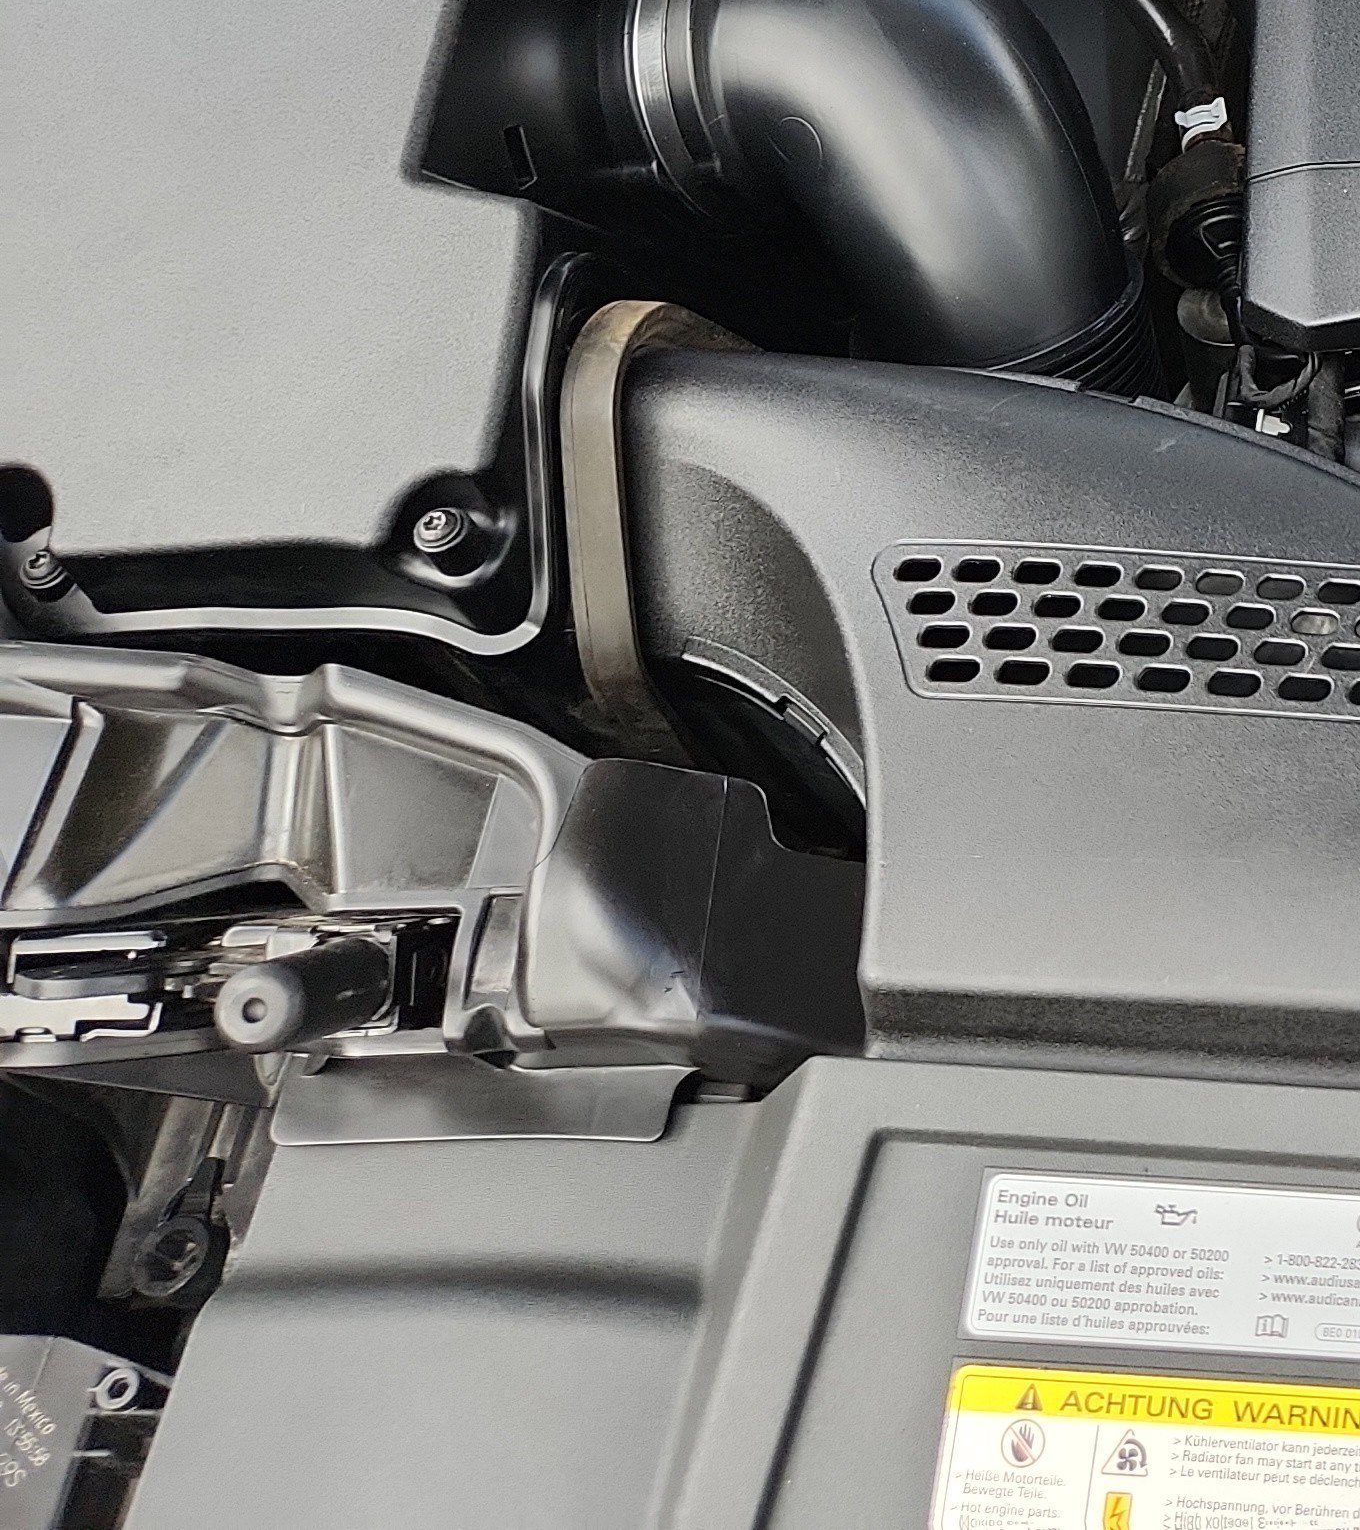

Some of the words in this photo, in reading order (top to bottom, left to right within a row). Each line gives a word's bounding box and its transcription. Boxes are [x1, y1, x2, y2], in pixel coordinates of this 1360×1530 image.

[997, 1190, 1058, 1208] Engine
[1064, 1193, 1089, 1208] Oil
[994, 1210, 1039, 1226] Huile
[1044, 1217, 1114, 1230] moteur
[990, 1236, 1015, 1249] Use
[1018, 1238, 1047, 1253] only
[1051, 1240, 1068, 1252] oil
[1071, 1242, 1099, 1254] with
[1104, 1242, 1128, 1256] VW
[1130, 1244, 1169, 1258] 50400
[1172, 1249, 1188, 1260] or
[1190, 1248, 1229, 1262] 50200
[987, 1256, 1048, 1271] approval.
[1053, 1257, 1074, 1270] For
[1077, 1261, 1086, 1272] a
[1089, 1259, 1110, 1273] list
[1113, 1261, 1128, 1275] of
[1130, 1263, 1193, 1279] approved
[1196, 1266, 1224, 1280] oils:
[984, 1272, 1031, 1287] Utilisez
[1036, 1277, 1115, 1292] uniquement
[1118, 1280, 1142, 1294] des
[1146, 1282, 1185, 1297] huiles
[1188, 1287, 1220, 1299] avec
[982, 1291, 1005, 1304] VW
[1008, 1292, 1047, 1306] 50400
[1051, 1298, 1068, 1308] ou
[1071, 1296, 1110, 1311] 50200
[1114, 1298, 1198, 1316] approbation.
[977, 1309, 1009, 1322] Pour
[1012, 1314, 1037, 1325] une
[1041, 1312, 1068, 1326] liste
[1128, 1318, 1210, 1337] approuvées:
[14, 1390, 57, 1434] Mexico
[1059, 1390, 1214, 1421] ACHTUNG
[1185, 1435, 1279, 1452] Kühlerventilator
[1281, 1442, 1310, 1454] kann
[1182, 1450, 1232, 1464] Radiator
[1235, 1453, 1254, 1465] fan
[1257, 1457, 1283, 1469] may
[1285, 1457, 1313, 1470] start
[1315, 1460, 1328, 1470] at
[1330, 1462, 1351, 1474] any
[965, 1470, 1000, 1482] Heiße
[1003, 1471, 1067, 1487] Motorteile.
[1180, 1465, 1194, 1477] Le
[1197, 1466, 1260, 1481] ventilateur
[1263, 1471, 1290, 1484] peut
[1292, 1475, 1306, 1485] se
[963, 1483, 1014, 1497] Bewegte
[1018, 1486, 1048, 1499] Teile.
[960, 1502, 981, 1513] Hot
[984, 1503, 1025, 1517] engine
[1028, 1507, 1060, 1519] parts.
[1176, 1495, 1269, 1514] Hochspannung,
[1271, 1504, 1292, 1515] vor
[1295, 1504, 1349, 1519] Berühren
